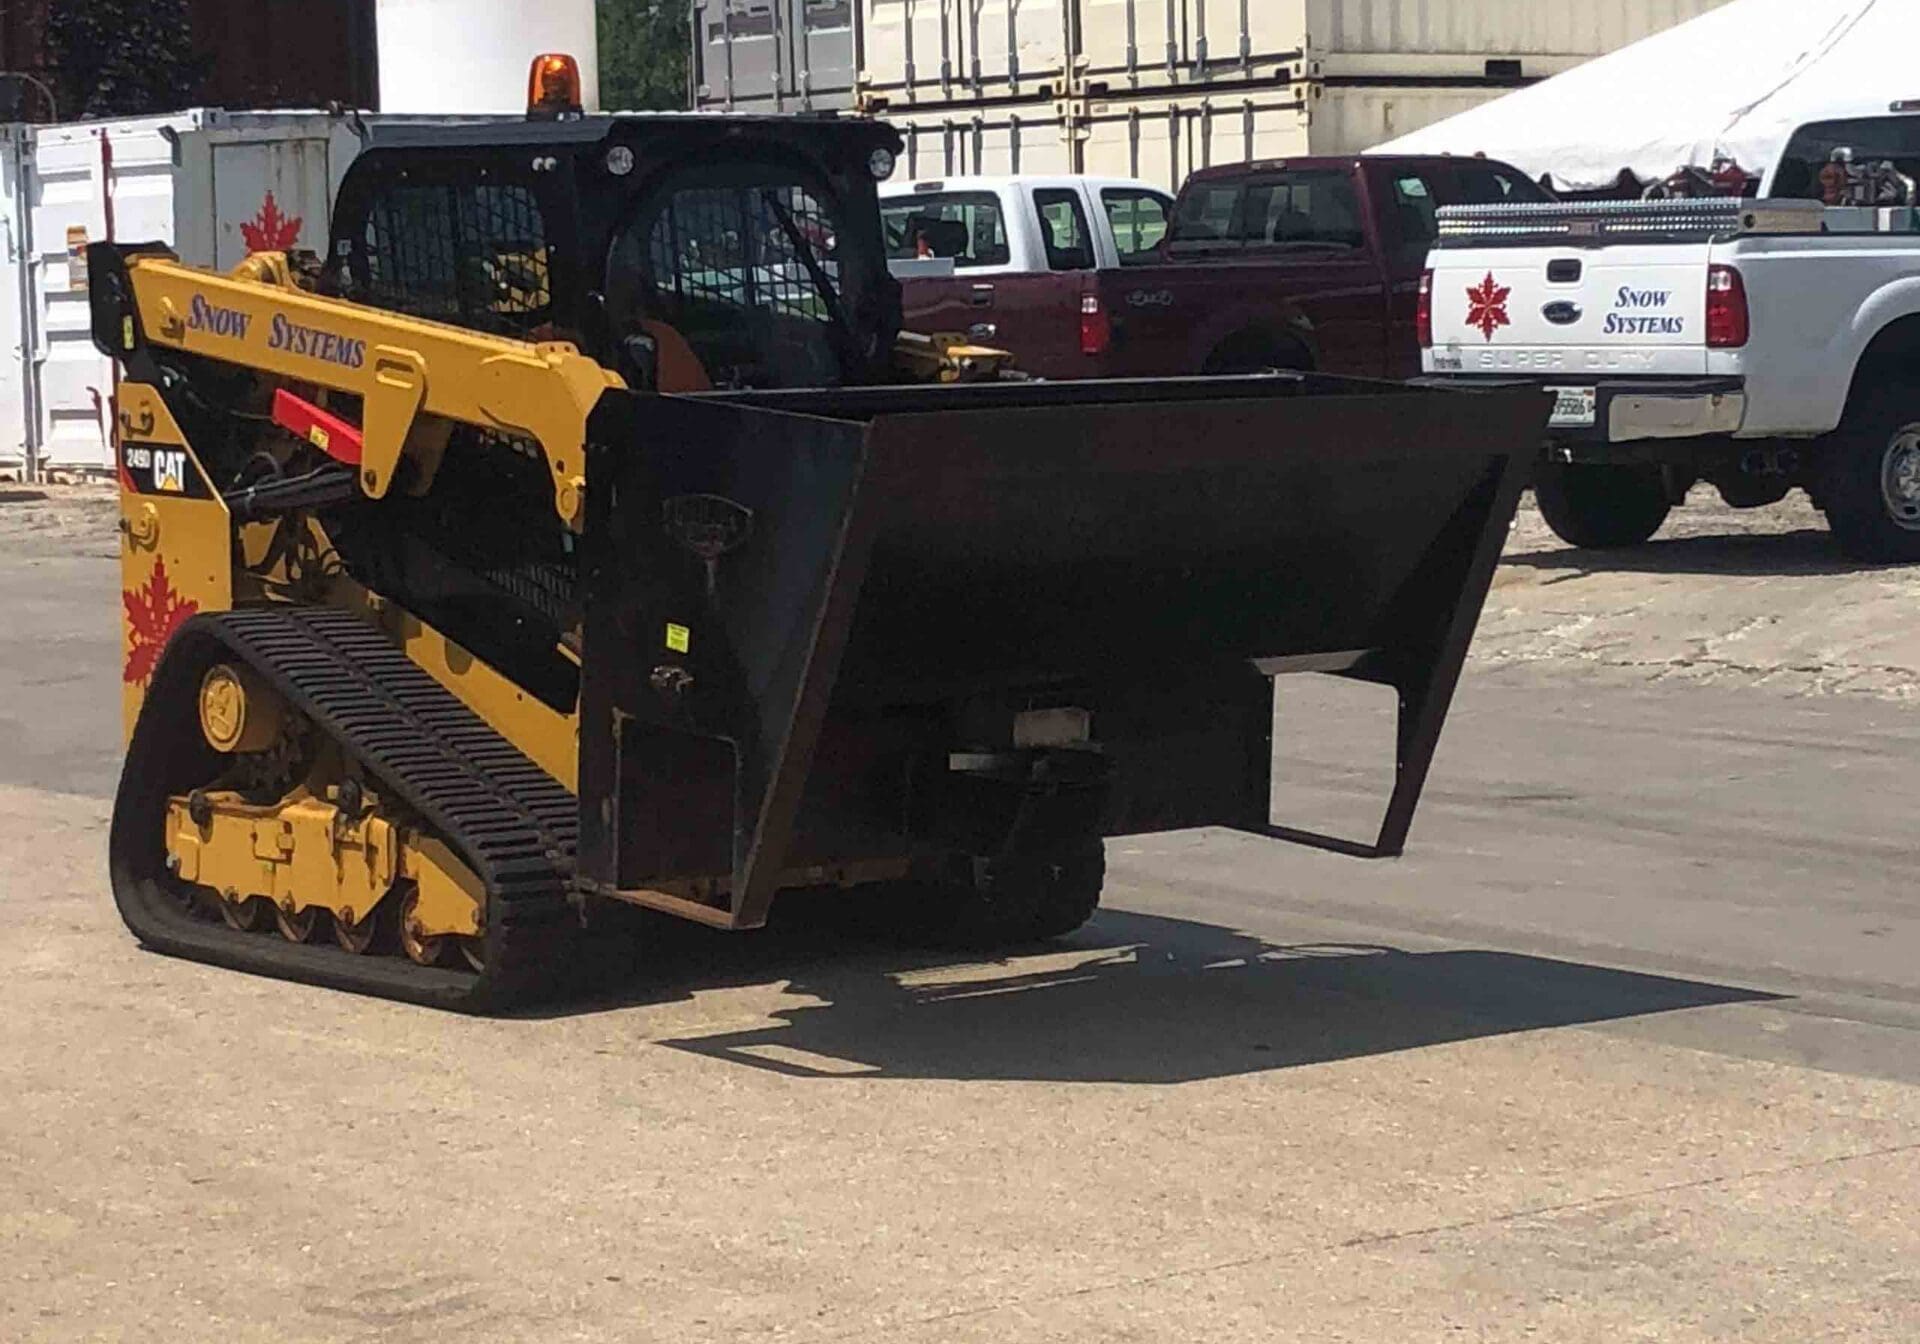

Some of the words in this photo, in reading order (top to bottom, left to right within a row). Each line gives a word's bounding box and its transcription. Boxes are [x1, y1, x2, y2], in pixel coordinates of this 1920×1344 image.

[1615, 286, 1672, 308] SNOW
[1603, 312, 1684, 334] SYSTEMS
[153, 449, 186, 492] CAT
